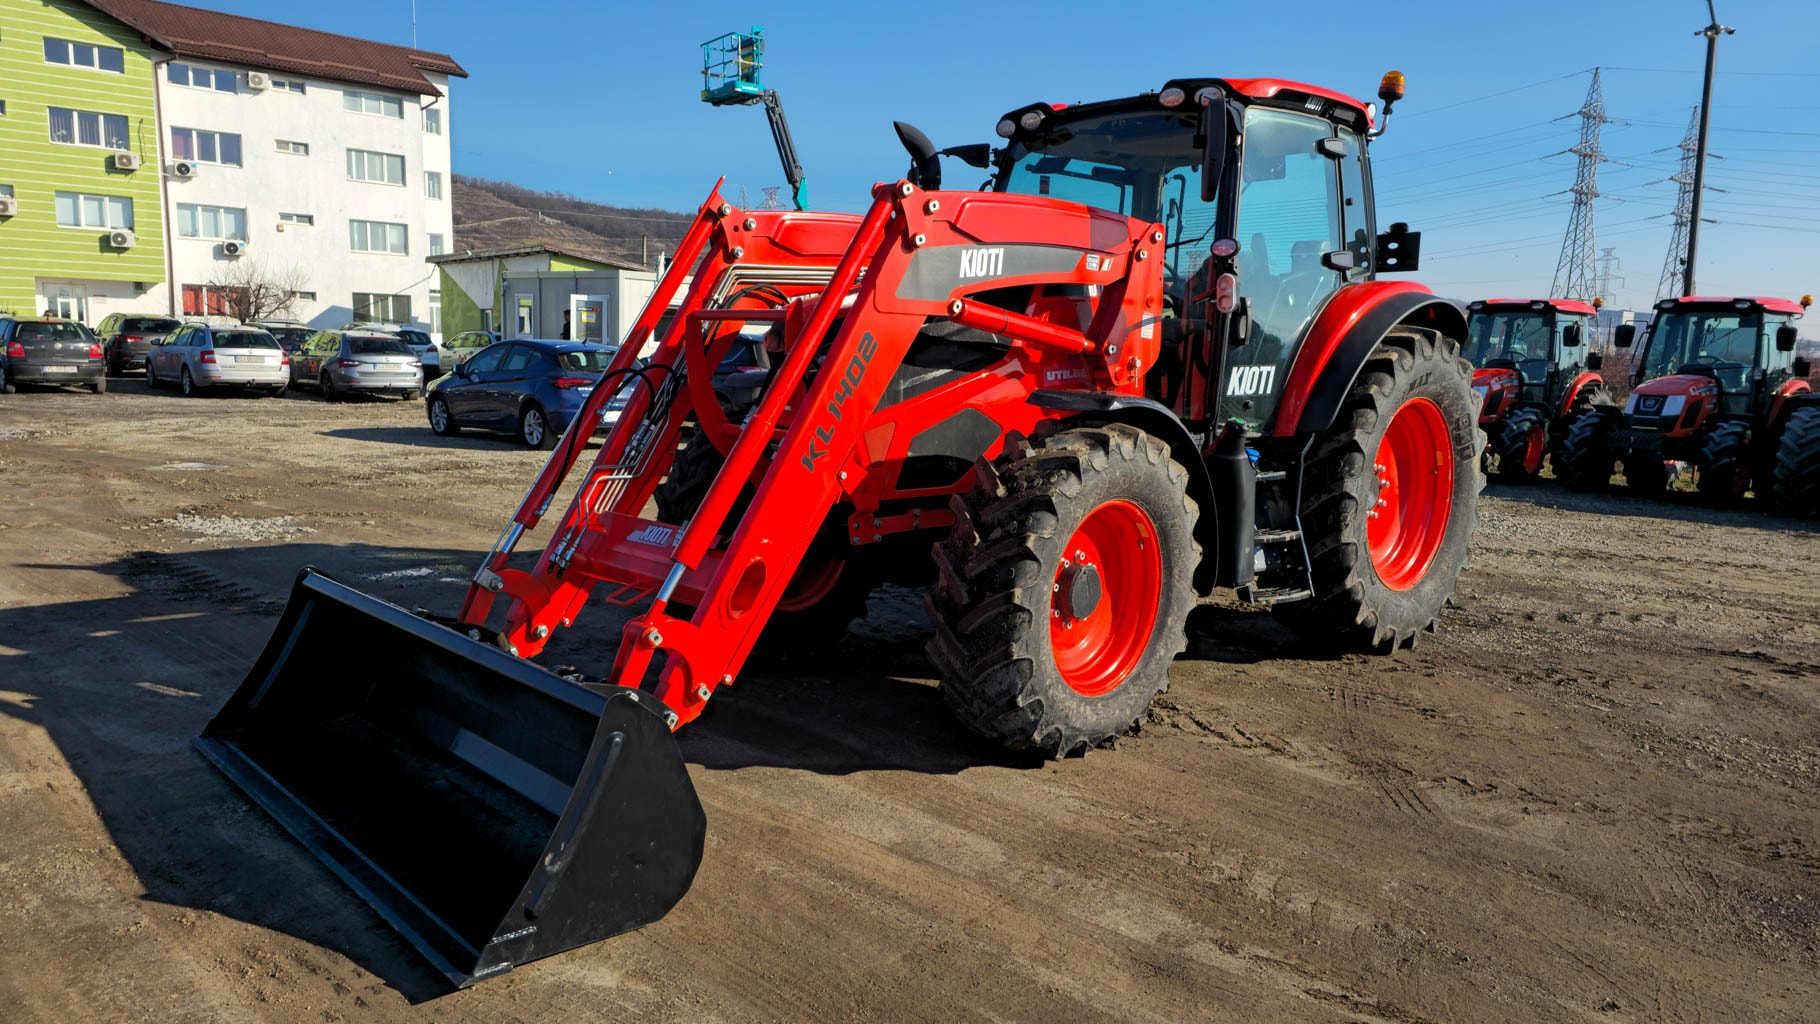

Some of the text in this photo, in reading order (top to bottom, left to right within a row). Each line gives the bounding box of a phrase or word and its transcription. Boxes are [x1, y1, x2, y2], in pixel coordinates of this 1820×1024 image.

[1304, 95, 1325, 111] KIOTI
[959, 248, 1005, 278] KIOTI
[1226, 365, 1276, 396] KIOTI
[640, 525, 673, 545] KIOTI
